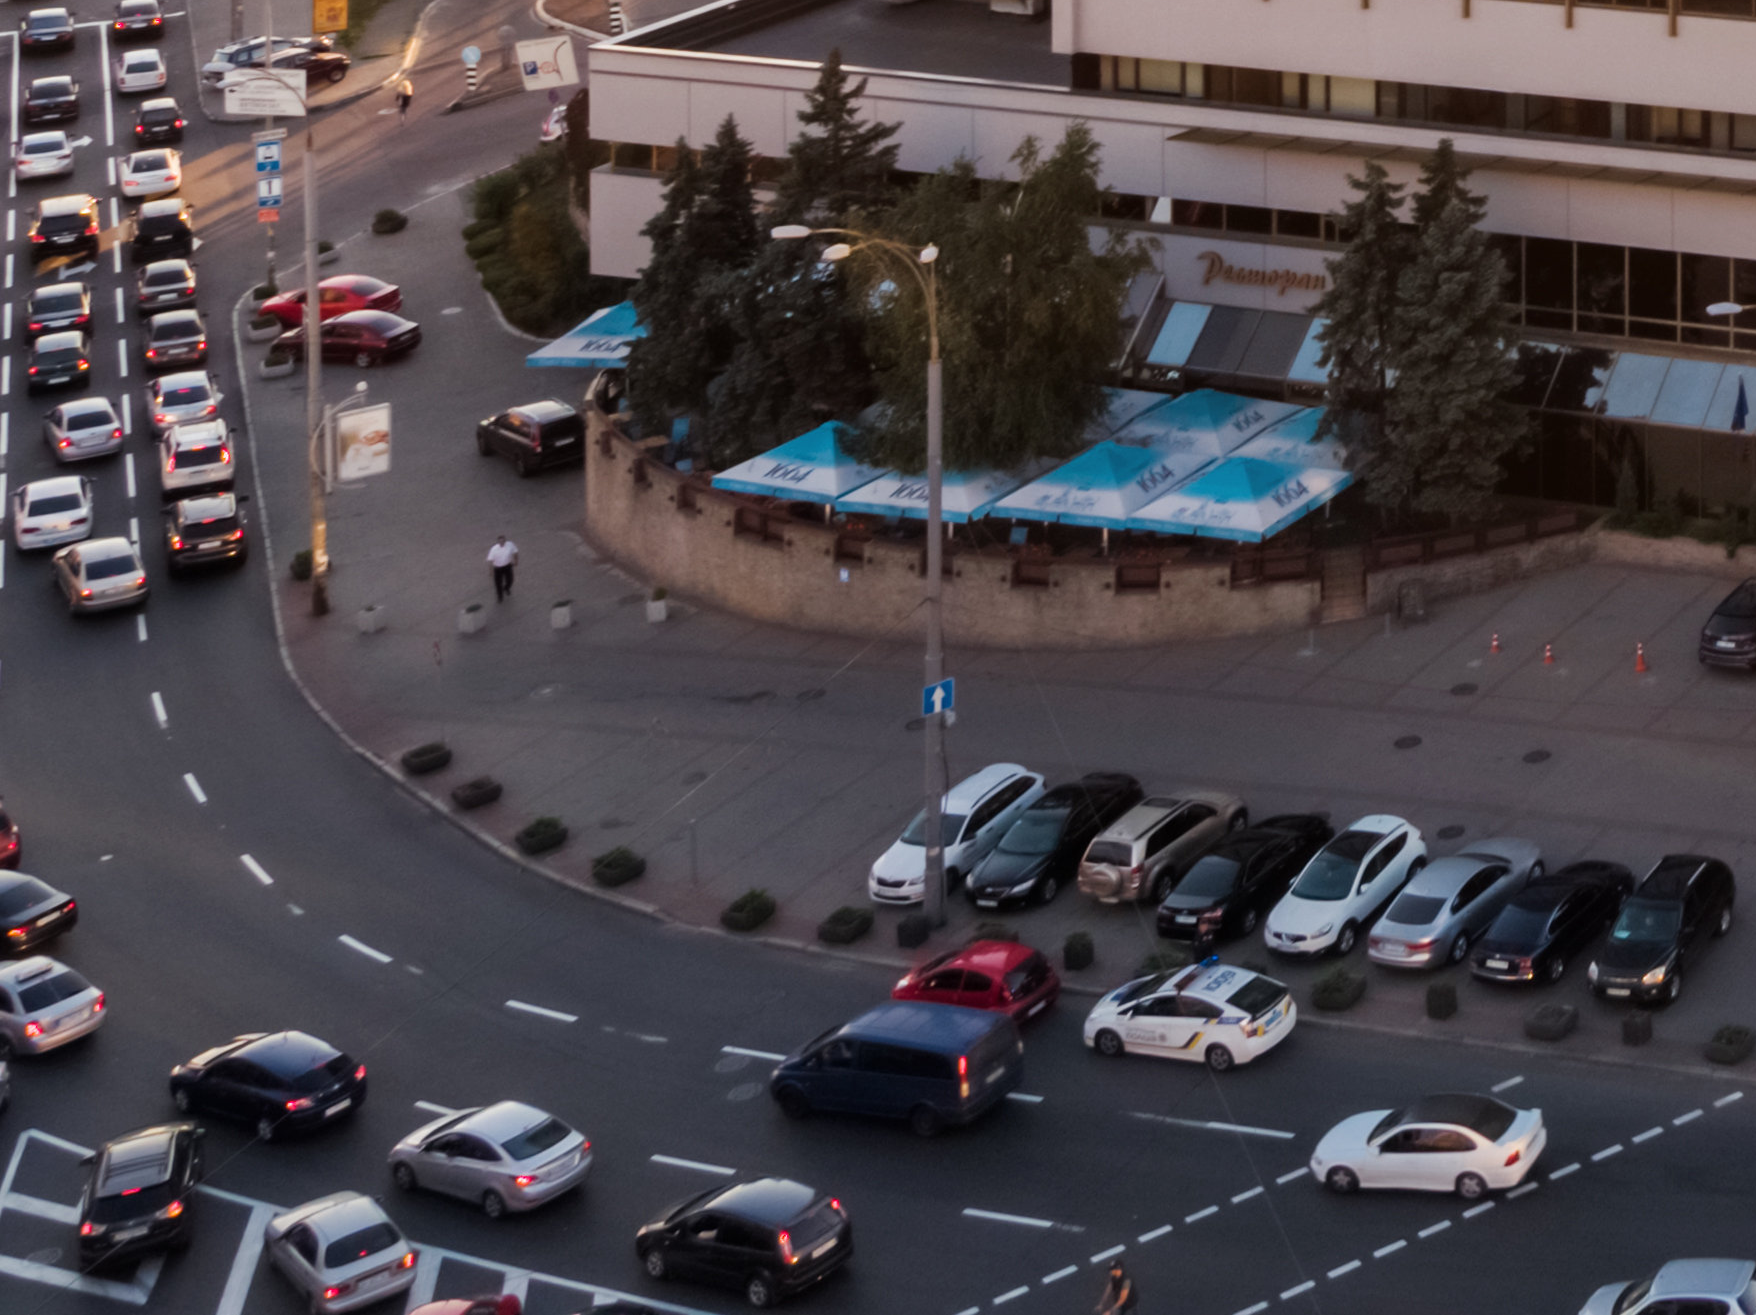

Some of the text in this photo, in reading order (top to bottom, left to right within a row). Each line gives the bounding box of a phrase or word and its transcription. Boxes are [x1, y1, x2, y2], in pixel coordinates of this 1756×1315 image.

[1196, 250, 1326, 296] Ресторан
[762, 462, 814, 485] 1664
[1136, 464, 1176, 494] 1664
[1271, 479, 1310, 508] 1664
